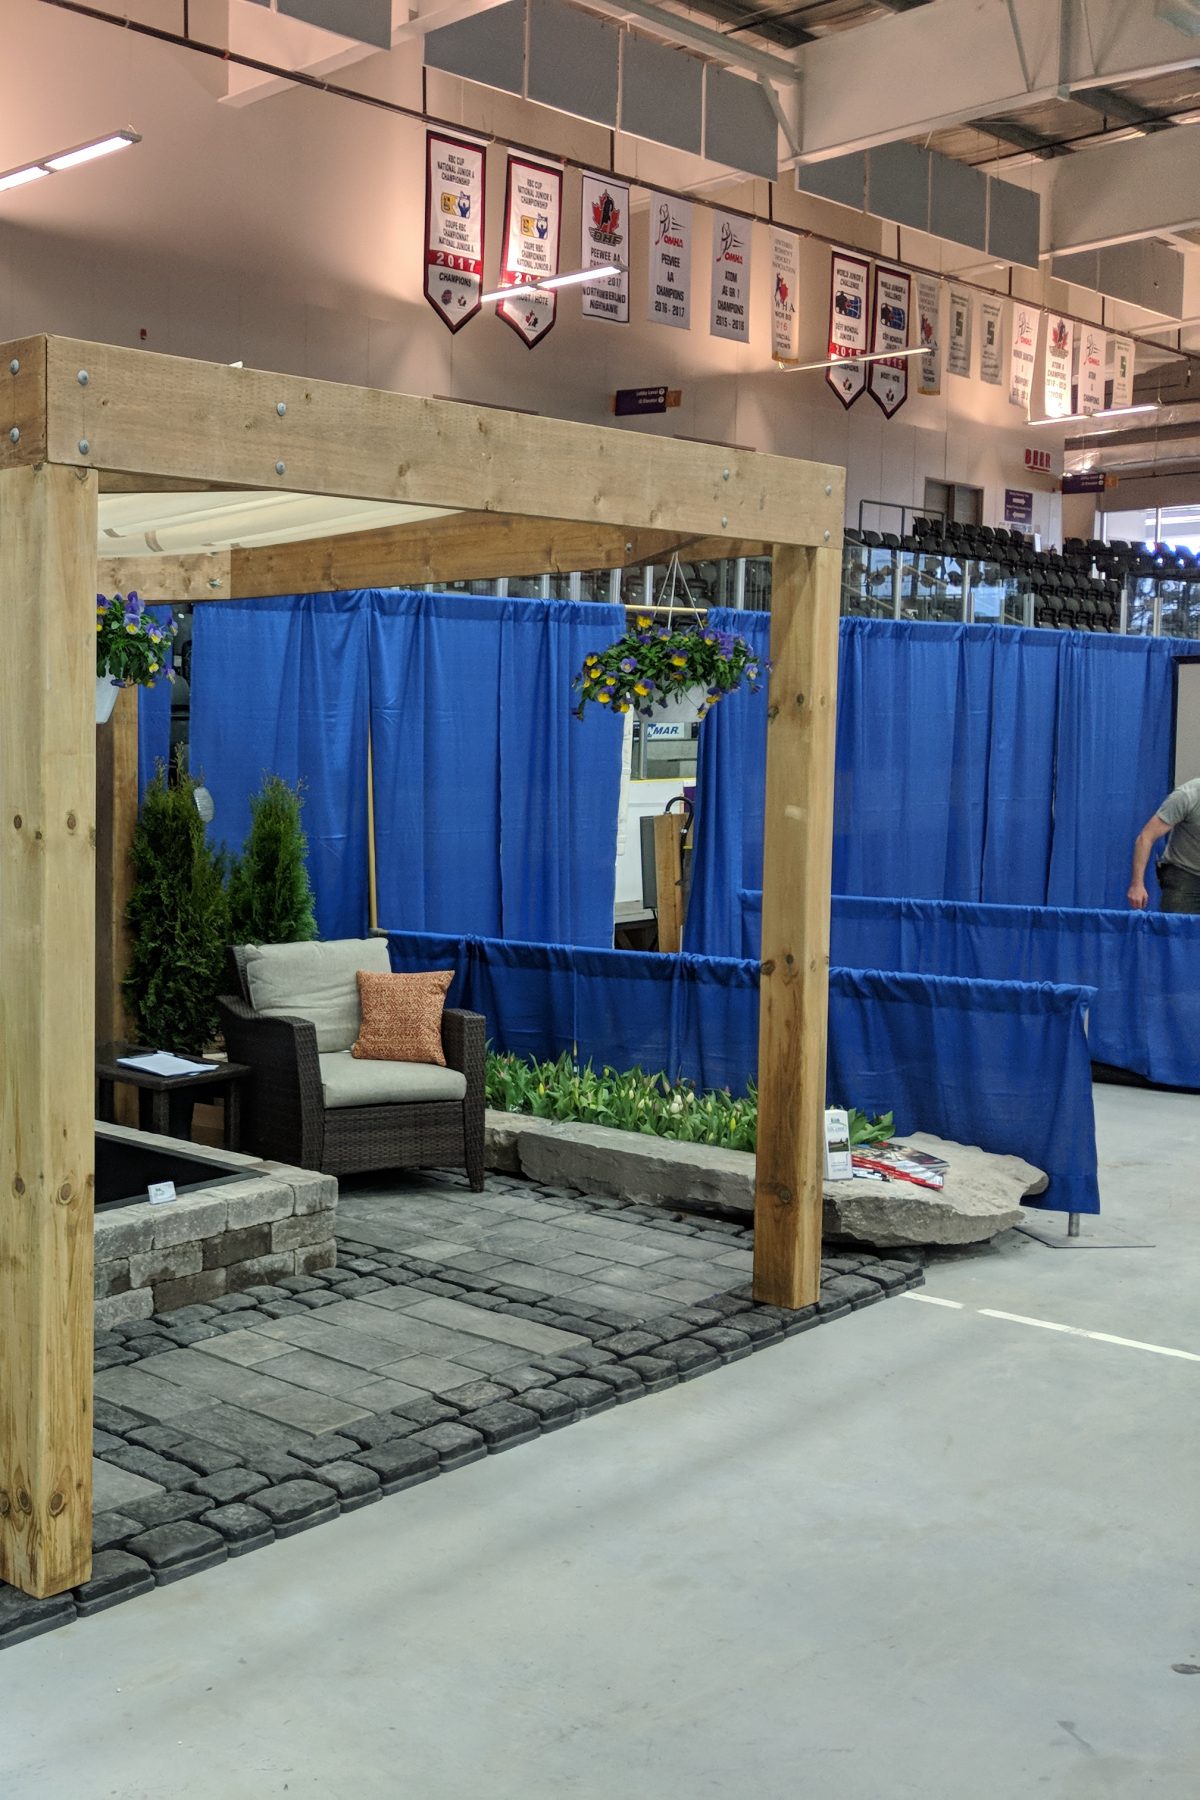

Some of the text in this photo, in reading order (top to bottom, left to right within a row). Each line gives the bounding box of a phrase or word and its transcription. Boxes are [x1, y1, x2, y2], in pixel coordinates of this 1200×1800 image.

[437, 161, 456, 174] NATIONAL
[441, 172, 470, 187] CHAMPIONSHIP
[518, 185, 535, 198] NATIONAL
[521, 196, 548, 210] CHAMPIONSHIP
[591, 247, 611, 260] PEEWEE
[436, 252, 476, 272] 2017
[438, 272, 472, 287] CHAMPIONS
[656, 285, 684, 301] CHAMPIONS
[717, 300, 744, 315] CHAMPIONS
